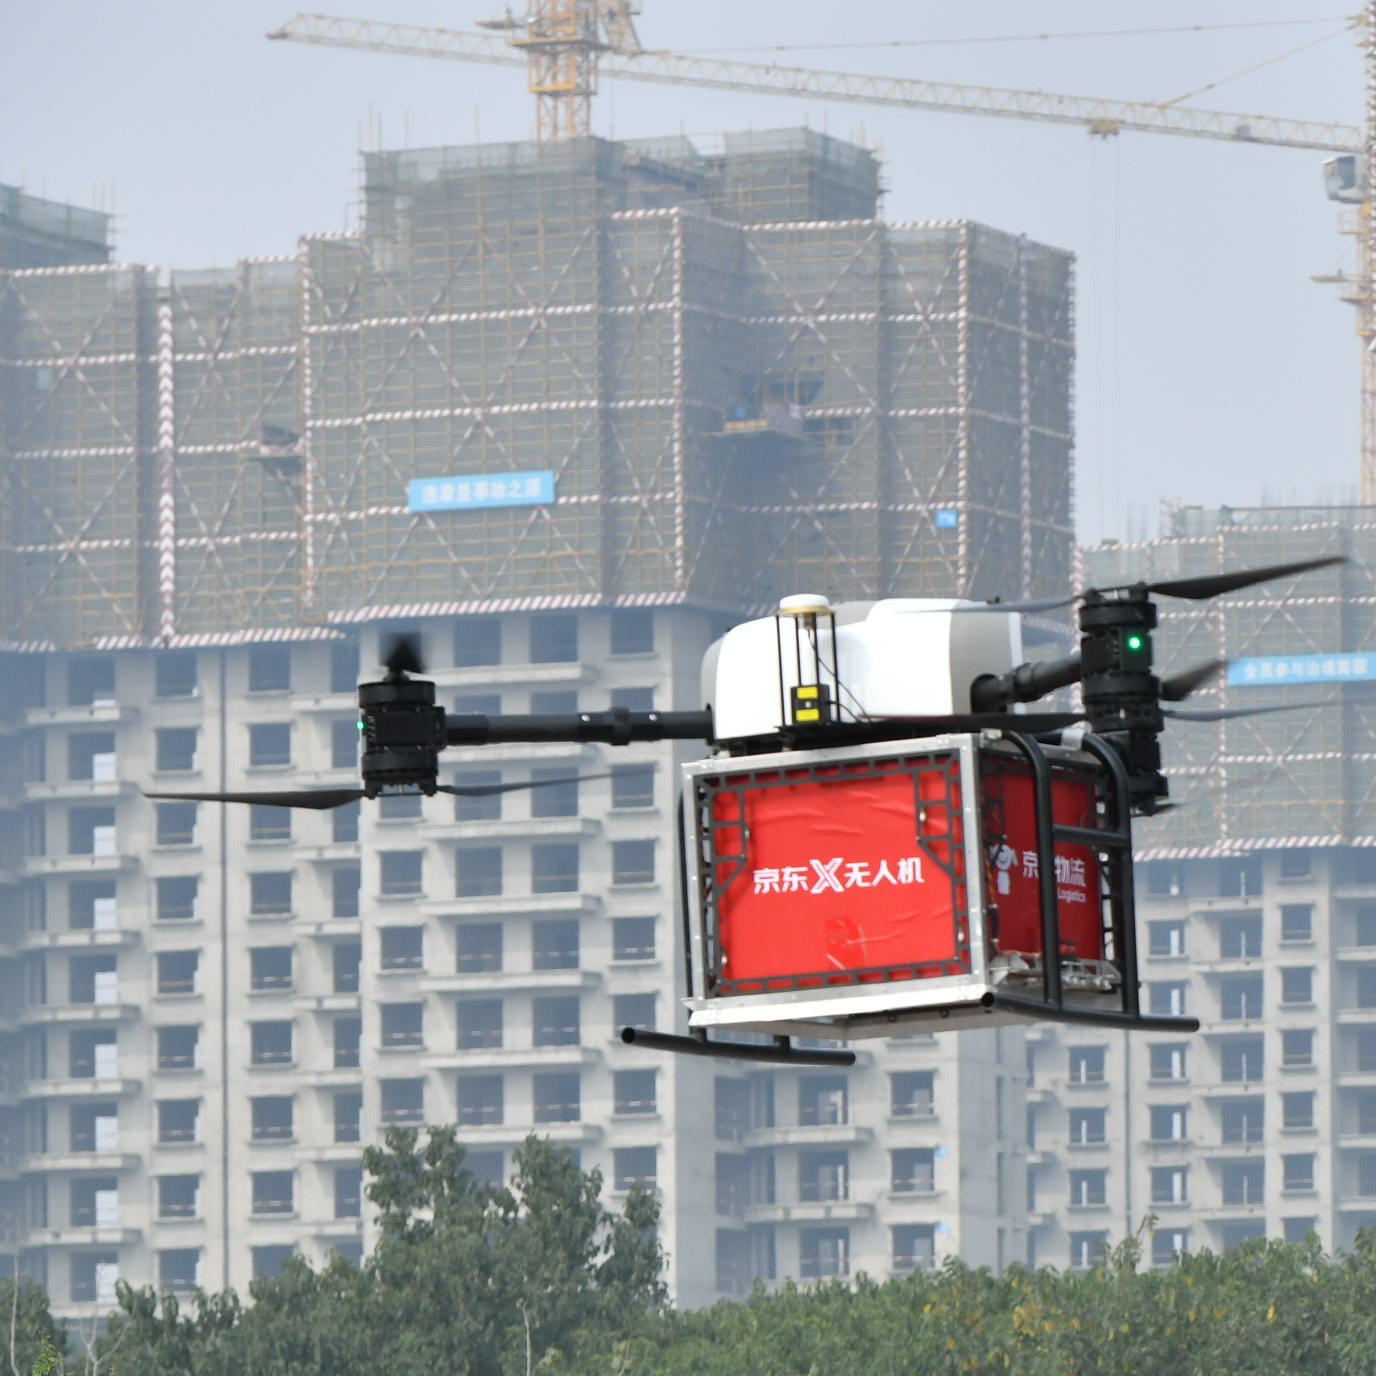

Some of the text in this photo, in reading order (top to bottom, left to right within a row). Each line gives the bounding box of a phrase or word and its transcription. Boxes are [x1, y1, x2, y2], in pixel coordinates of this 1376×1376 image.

[753, 857, 925, 895] 京东X无人机
[1022, 850, 1087, 888] 京物流
